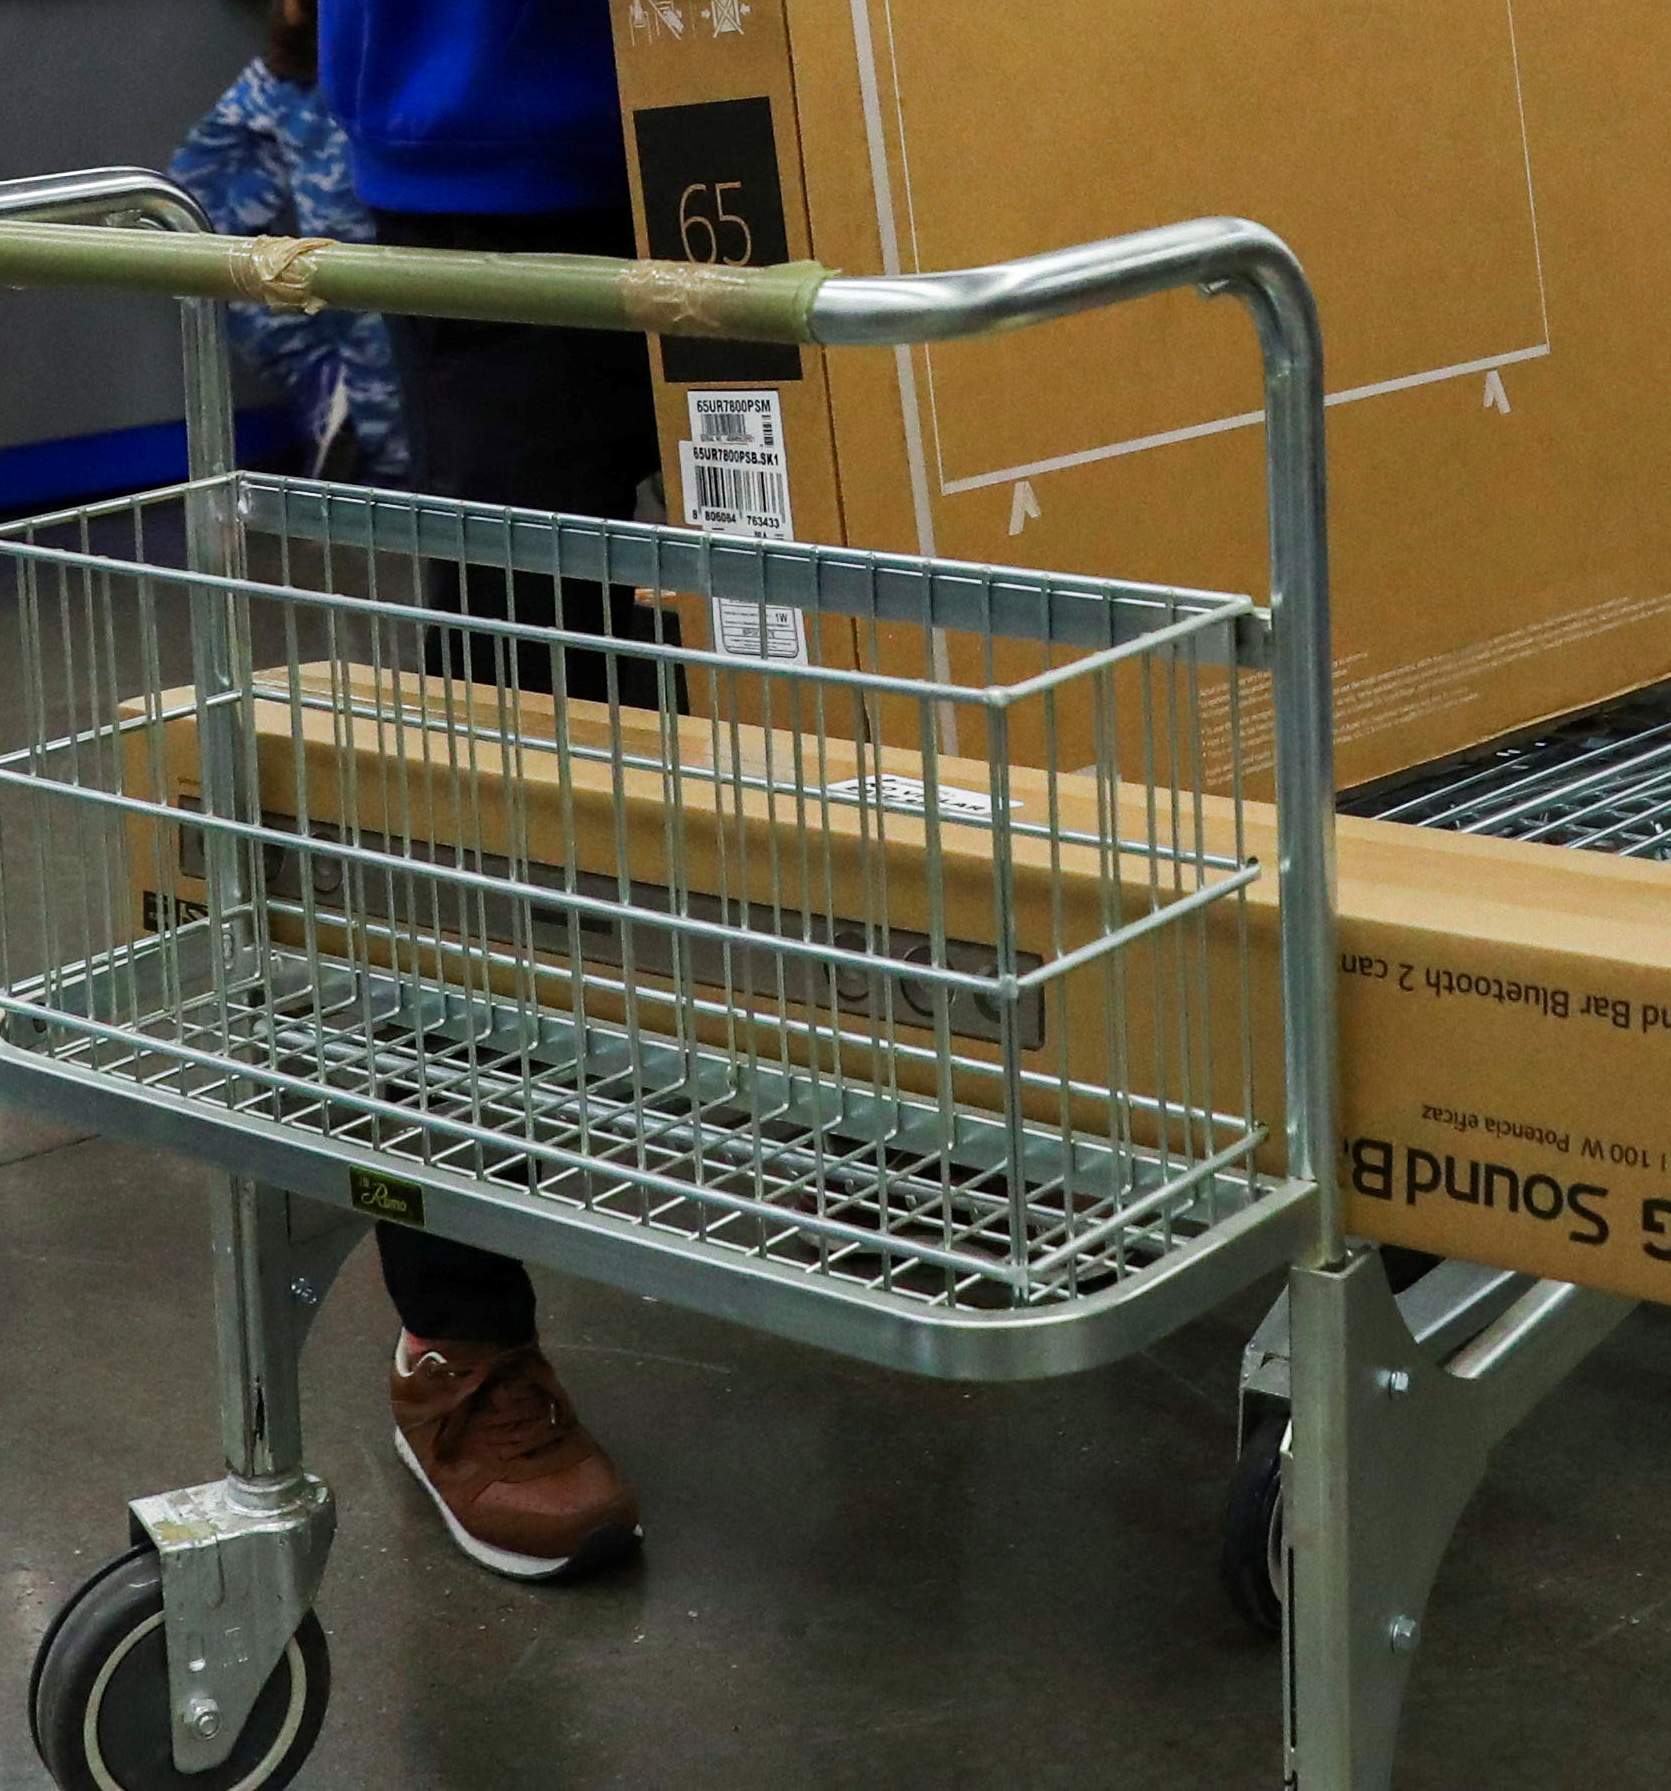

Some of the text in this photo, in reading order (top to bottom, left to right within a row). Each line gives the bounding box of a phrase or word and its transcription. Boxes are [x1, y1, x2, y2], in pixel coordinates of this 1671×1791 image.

[677, 181, 753, 266] 65
[697, 399, 771, 413] 65UR7800PSM
[747, 515, 780, 529] 763433
[1399, 964, 1414, 992] 2
[1425, 969, 1570, 1019] Bluetooth
[1580, 995, 1630, 1030] Bar
[1420, 1104, 1479, 1133] eficaz
[1484, 1116, 1570, 1153] Potencia
[1580, 1137, 1603, 1158] W
[1610, 1142, 1650, 1170] 100
[1343, 1138, 1610, 1247] SoundB
